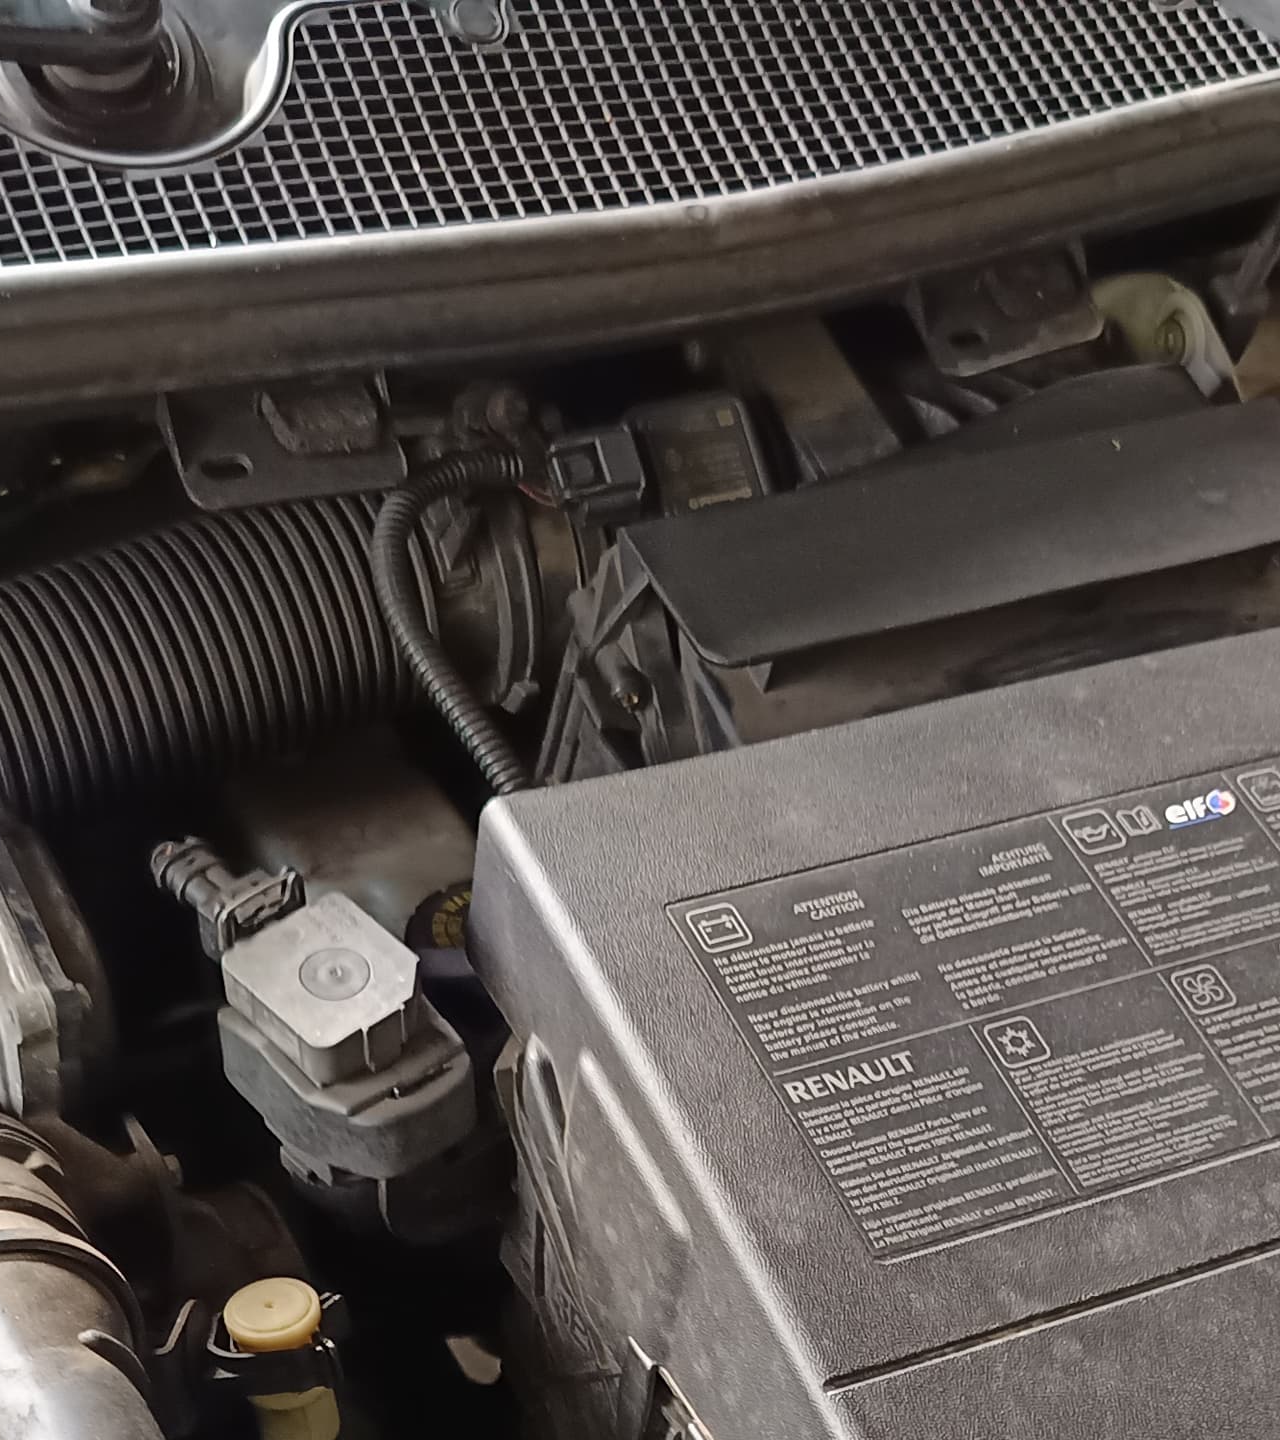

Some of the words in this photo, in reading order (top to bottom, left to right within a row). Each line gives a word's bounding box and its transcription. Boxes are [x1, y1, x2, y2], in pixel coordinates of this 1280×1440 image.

[1166, 796, 1206, 824] elf
[979, 852, 1052, 876] IMPORTANTE
[992, 843, 1047, 863] ACHTUNG
[794, 891, 858, 914] ATTENTION
[810, 901, 865, 920] CAUTION
[784, 1050, 915, 1103] RENAULT
